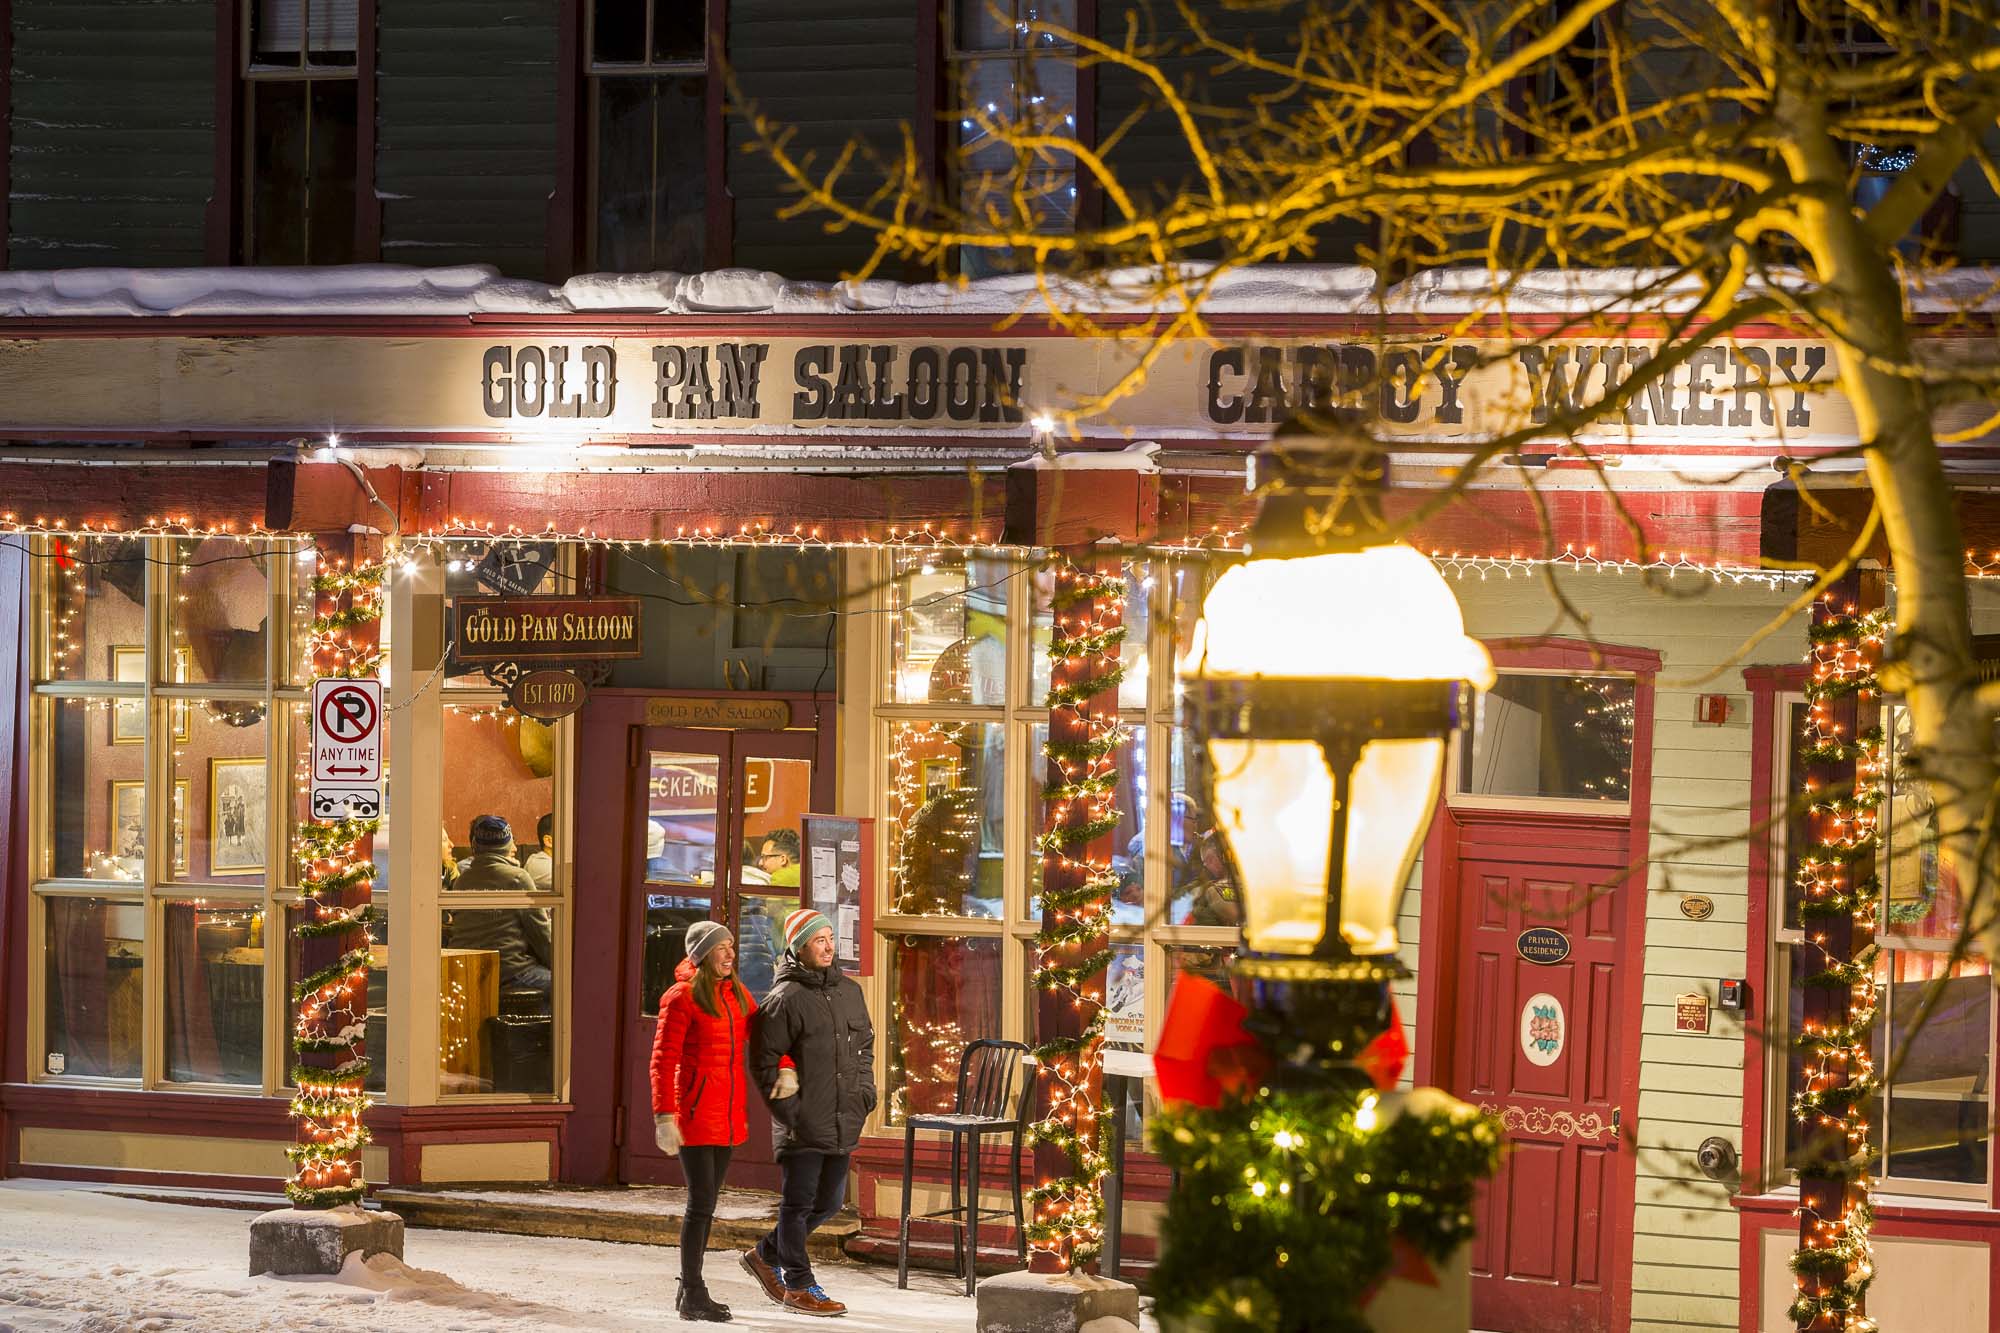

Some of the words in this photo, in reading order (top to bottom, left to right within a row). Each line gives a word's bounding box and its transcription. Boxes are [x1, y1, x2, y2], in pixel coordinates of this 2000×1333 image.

[482, 345, 617, 418] GOLD
[651, 343, 769, 420] PAN
[792, 345, 1026, 422] SALOON
[1519, 345, 1825, 428] WINERY
[477, 607, 489, 617] THE
[466, 614, 516, 644] GOLD
[520, 613, 559, 642] PAN
[562, 612, 634, 642] SALOON
[548, 682, 575, 704] 1879
[650, 704, 688, 719] GOLD
[693, 705, 721, 720] PAN
[726, 706, 784, 721] SALOON
[320, 747, 344, 761] ANY
[347, 747, 375, 761] TIME
[1527, 935, 1559, 946] PRIVATE
[1523, 946, 1564, 956] RESIDENCE
